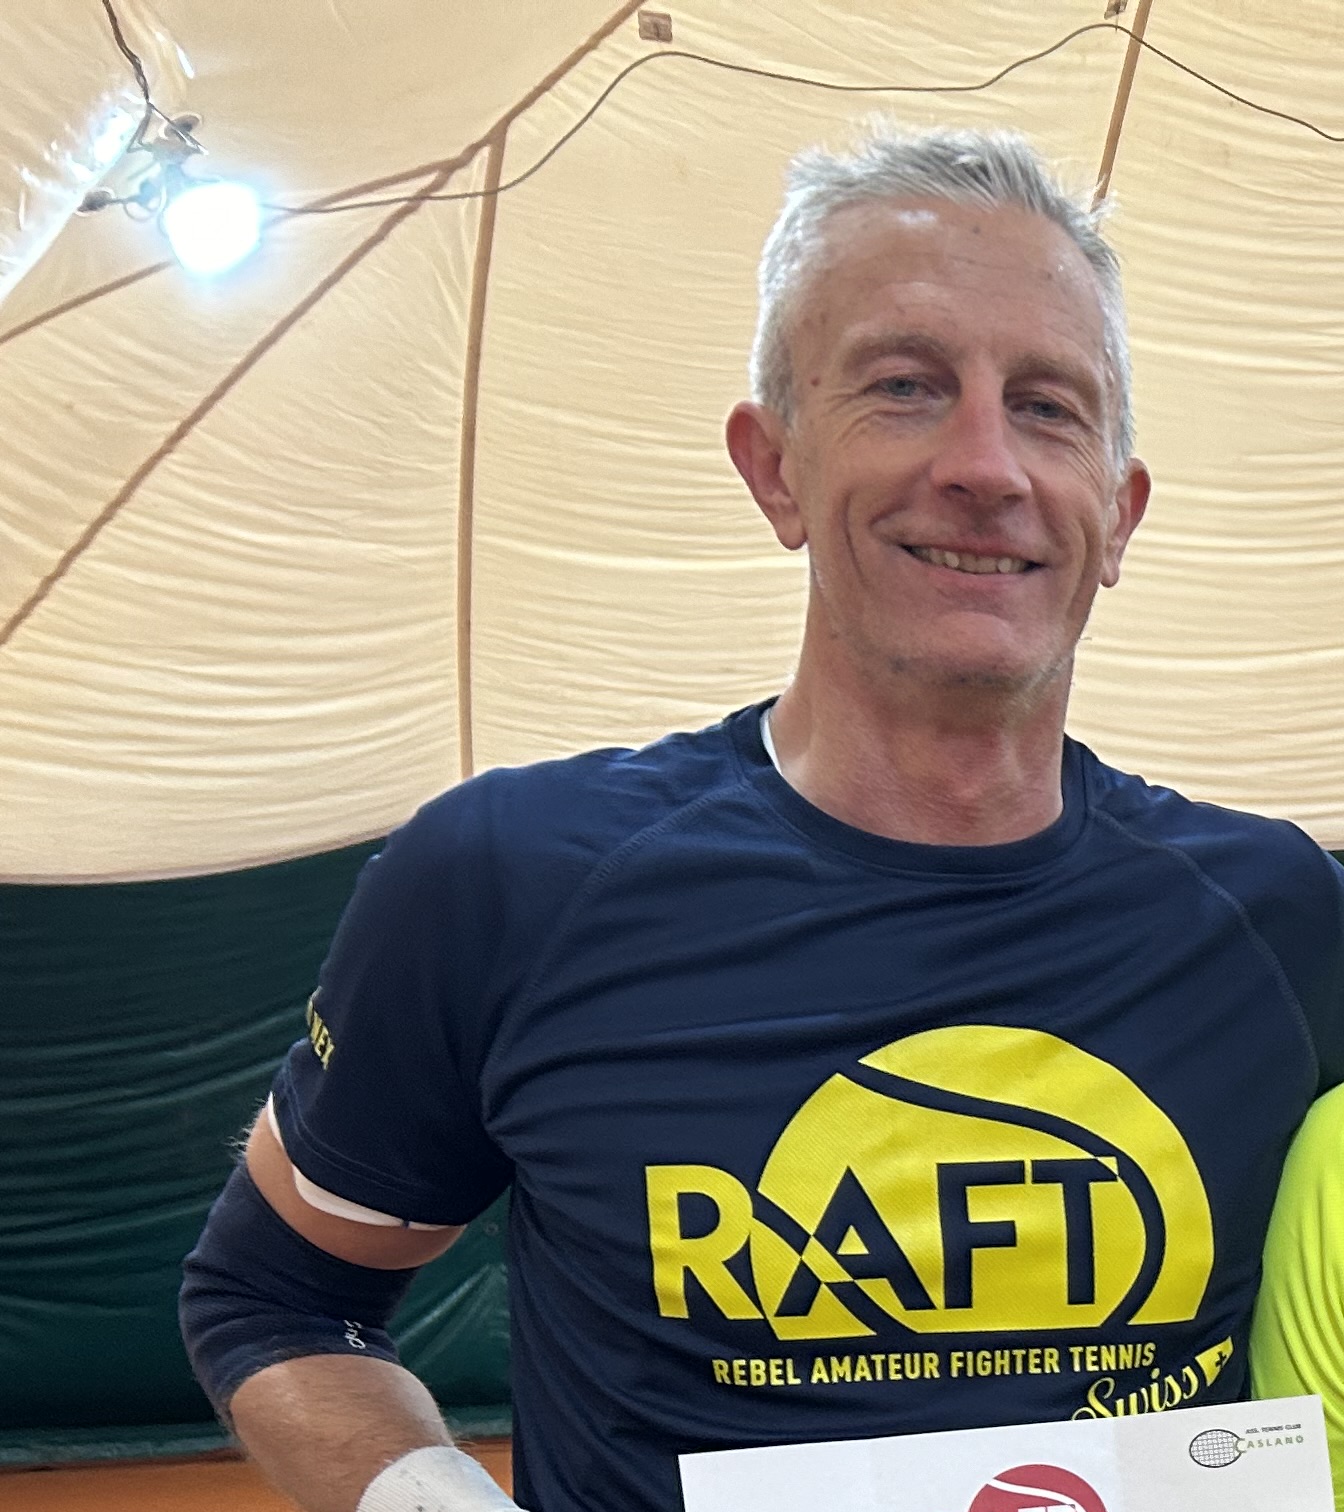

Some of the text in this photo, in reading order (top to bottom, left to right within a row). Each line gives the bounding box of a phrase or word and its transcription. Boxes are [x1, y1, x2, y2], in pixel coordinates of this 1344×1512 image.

[646, 1156, 1118, 1321] RAFT
[712, 1342, 1157, 1386] REBEL AMATEUR FIGHTER TENNIS
[1071, 1365, 1199, 1421] Swiss
